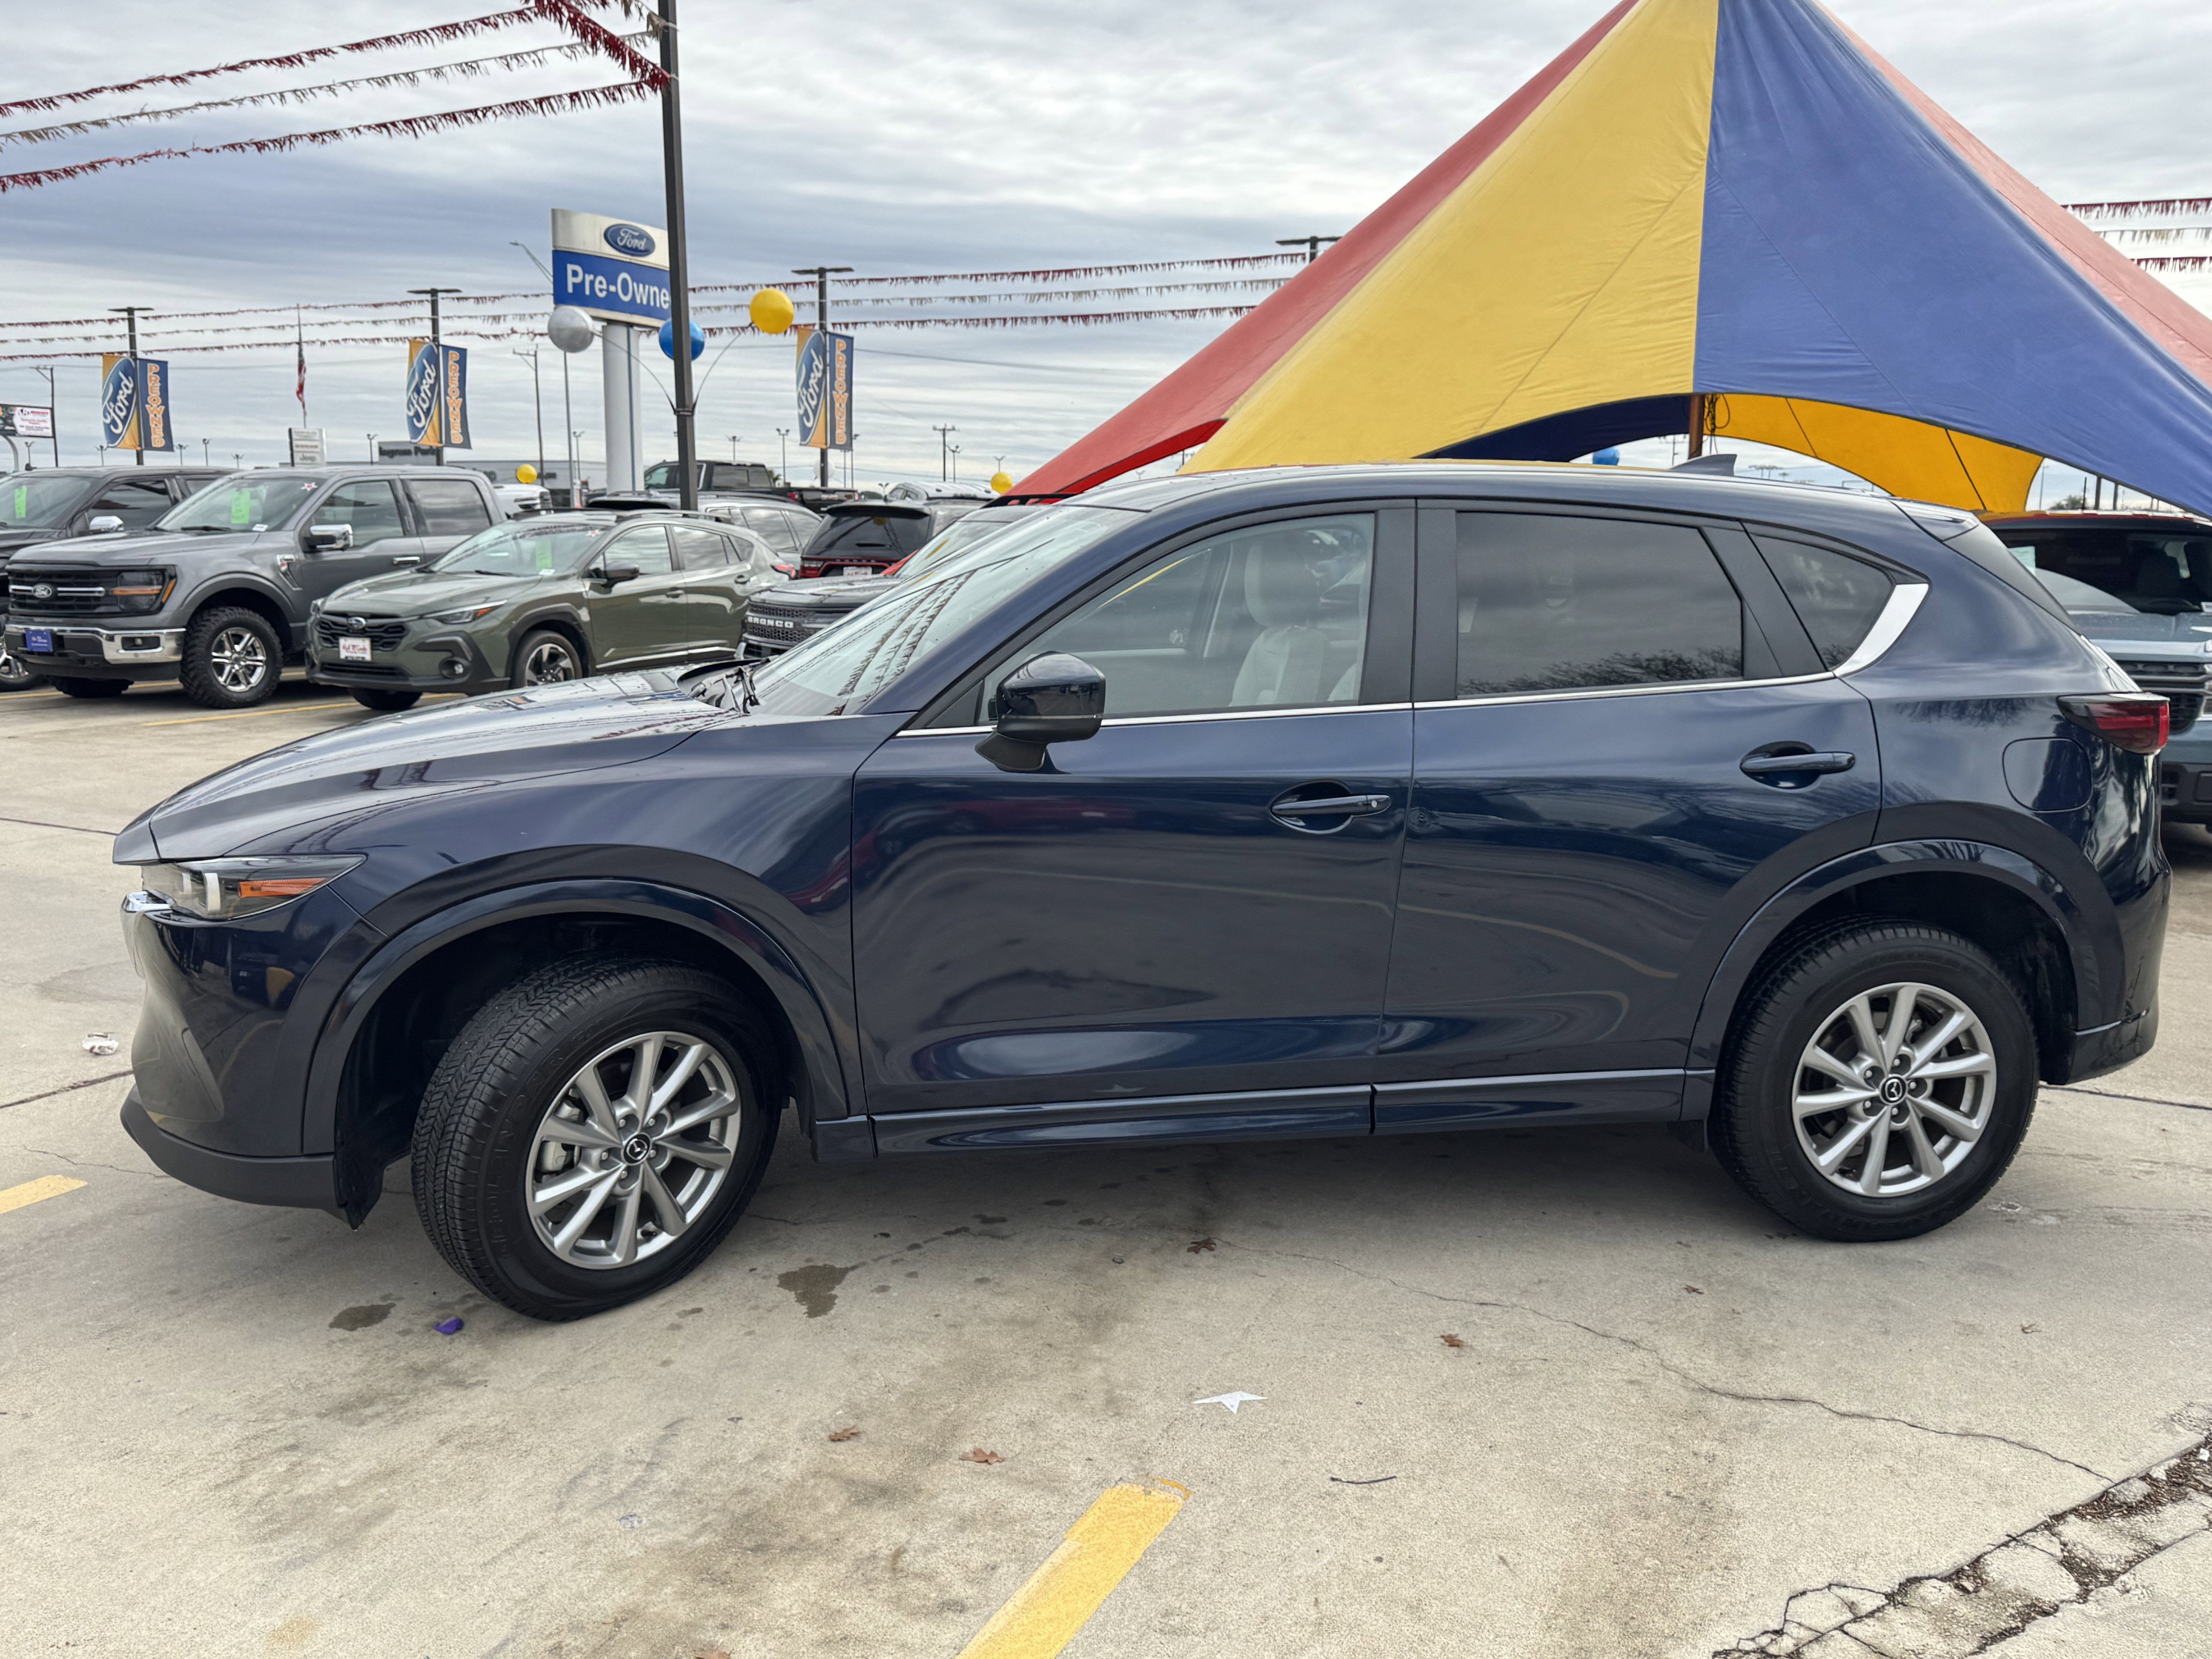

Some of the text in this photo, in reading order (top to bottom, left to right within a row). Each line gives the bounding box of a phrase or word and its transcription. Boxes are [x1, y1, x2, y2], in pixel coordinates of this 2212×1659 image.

[617, 228, 647, 251] Ford
[567, 263, 670, 310] Pre-Owne
[102, 370, 134, 434] Ford
[145, 362, 166, 448] PREOWNED
[406, 358, 436, 428] Ford
[446, 350, 464, 444] PREOWNED
[797, 348, 824, 428] Ford
[832, 338, 849, 445] PREOWNED
[747, 616, 794, 629] BRONCO
